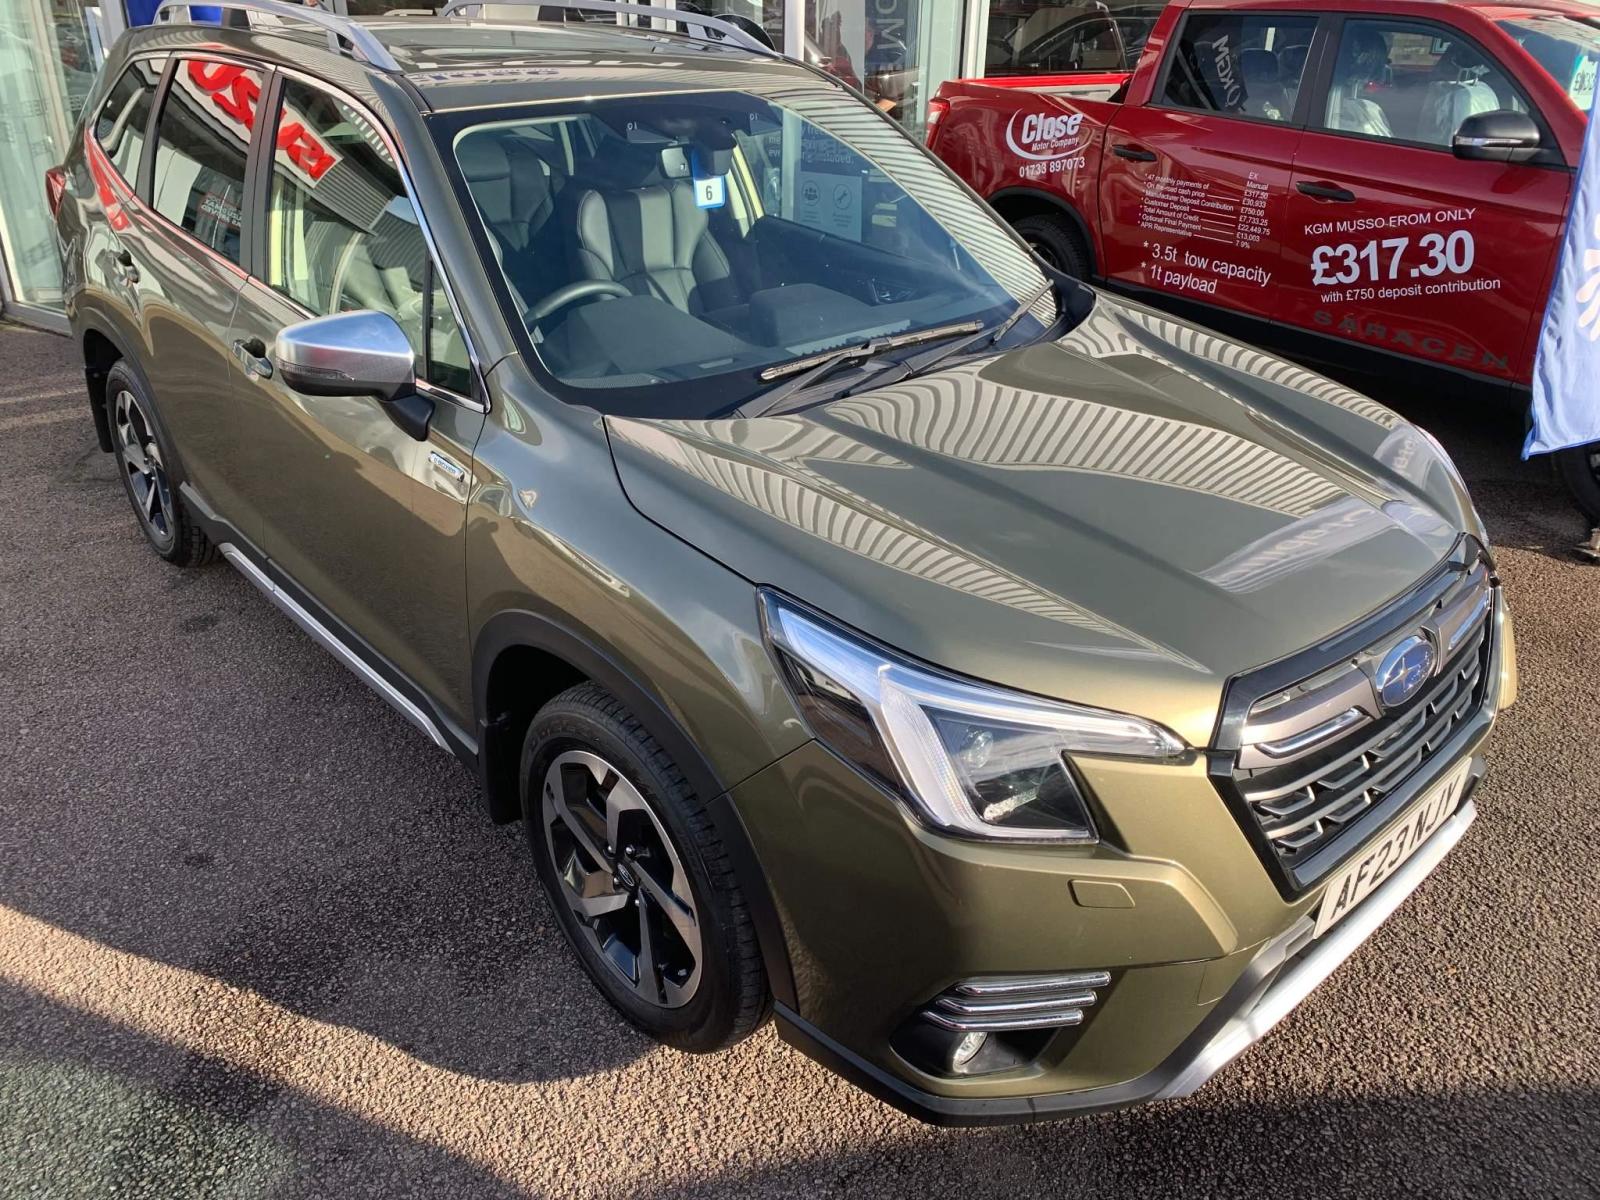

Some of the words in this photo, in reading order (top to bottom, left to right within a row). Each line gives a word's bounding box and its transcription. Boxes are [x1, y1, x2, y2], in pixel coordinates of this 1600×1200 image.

[1022, 112, 1084, 144] Close
[1032, 142, 1049, 151] Motor
[1050, 137, 1080, 149] Company
[1019, 162, 1047, 178] 01733
[1049, 156, 1086, 173] 897073
[705, 185, 713, 201] 6
[1175, 179, 1202, 190] payments
[1246, 180, 1269, 191] Manual
[1180, 196, 1200, 207] Deposit
[1200, 200, 1234, 212] Contribution
[1191, 190, 1206, 199] price
[1143, 198, 1169, 209] Customer
[1169, 202, 1190, 213] Deposit
[1143, 205, 1156, 215] Total
[1155, 207, 1177, 218] Amount
[1176, 210, 1183, 219] of
[1183, 211, 1200, 223] Credit
[1140, 221, 1153, 230] APR
[1153, 223, 1193, 238] Representative
[1142, 213, 1164, 225] Optional
[1164, 216, 1178, 227] Final
[1178, 219, 1202, 232] Payment
[1304, 222, 1334, 235] KGM
[1336, 217, 1385, 233] MUSSO
[1389, 211, 1432, 228] FROM
[1435, 207, 1477, 223] ONLY
[1151, 243, 1178, 263] 3.5t
[1184, 250, 1209, 270] tow
[1212, 259, 1272, 288] capacity
[1310, 229, 1476, 287] £317.30
[1150, 264, 1162, 281] 1t
[1163, 271, 1218, 294] payload
[1320, 289, 1343, 304] with
[1346, 287, 1376, 302] £750
[1377, 283, 1423, 300] deposit
[1425, 277, 1502, 296] contribution
[1312, 309, 1510, 370] SARACEN
[1329, 823, 1411, 921] AF23
